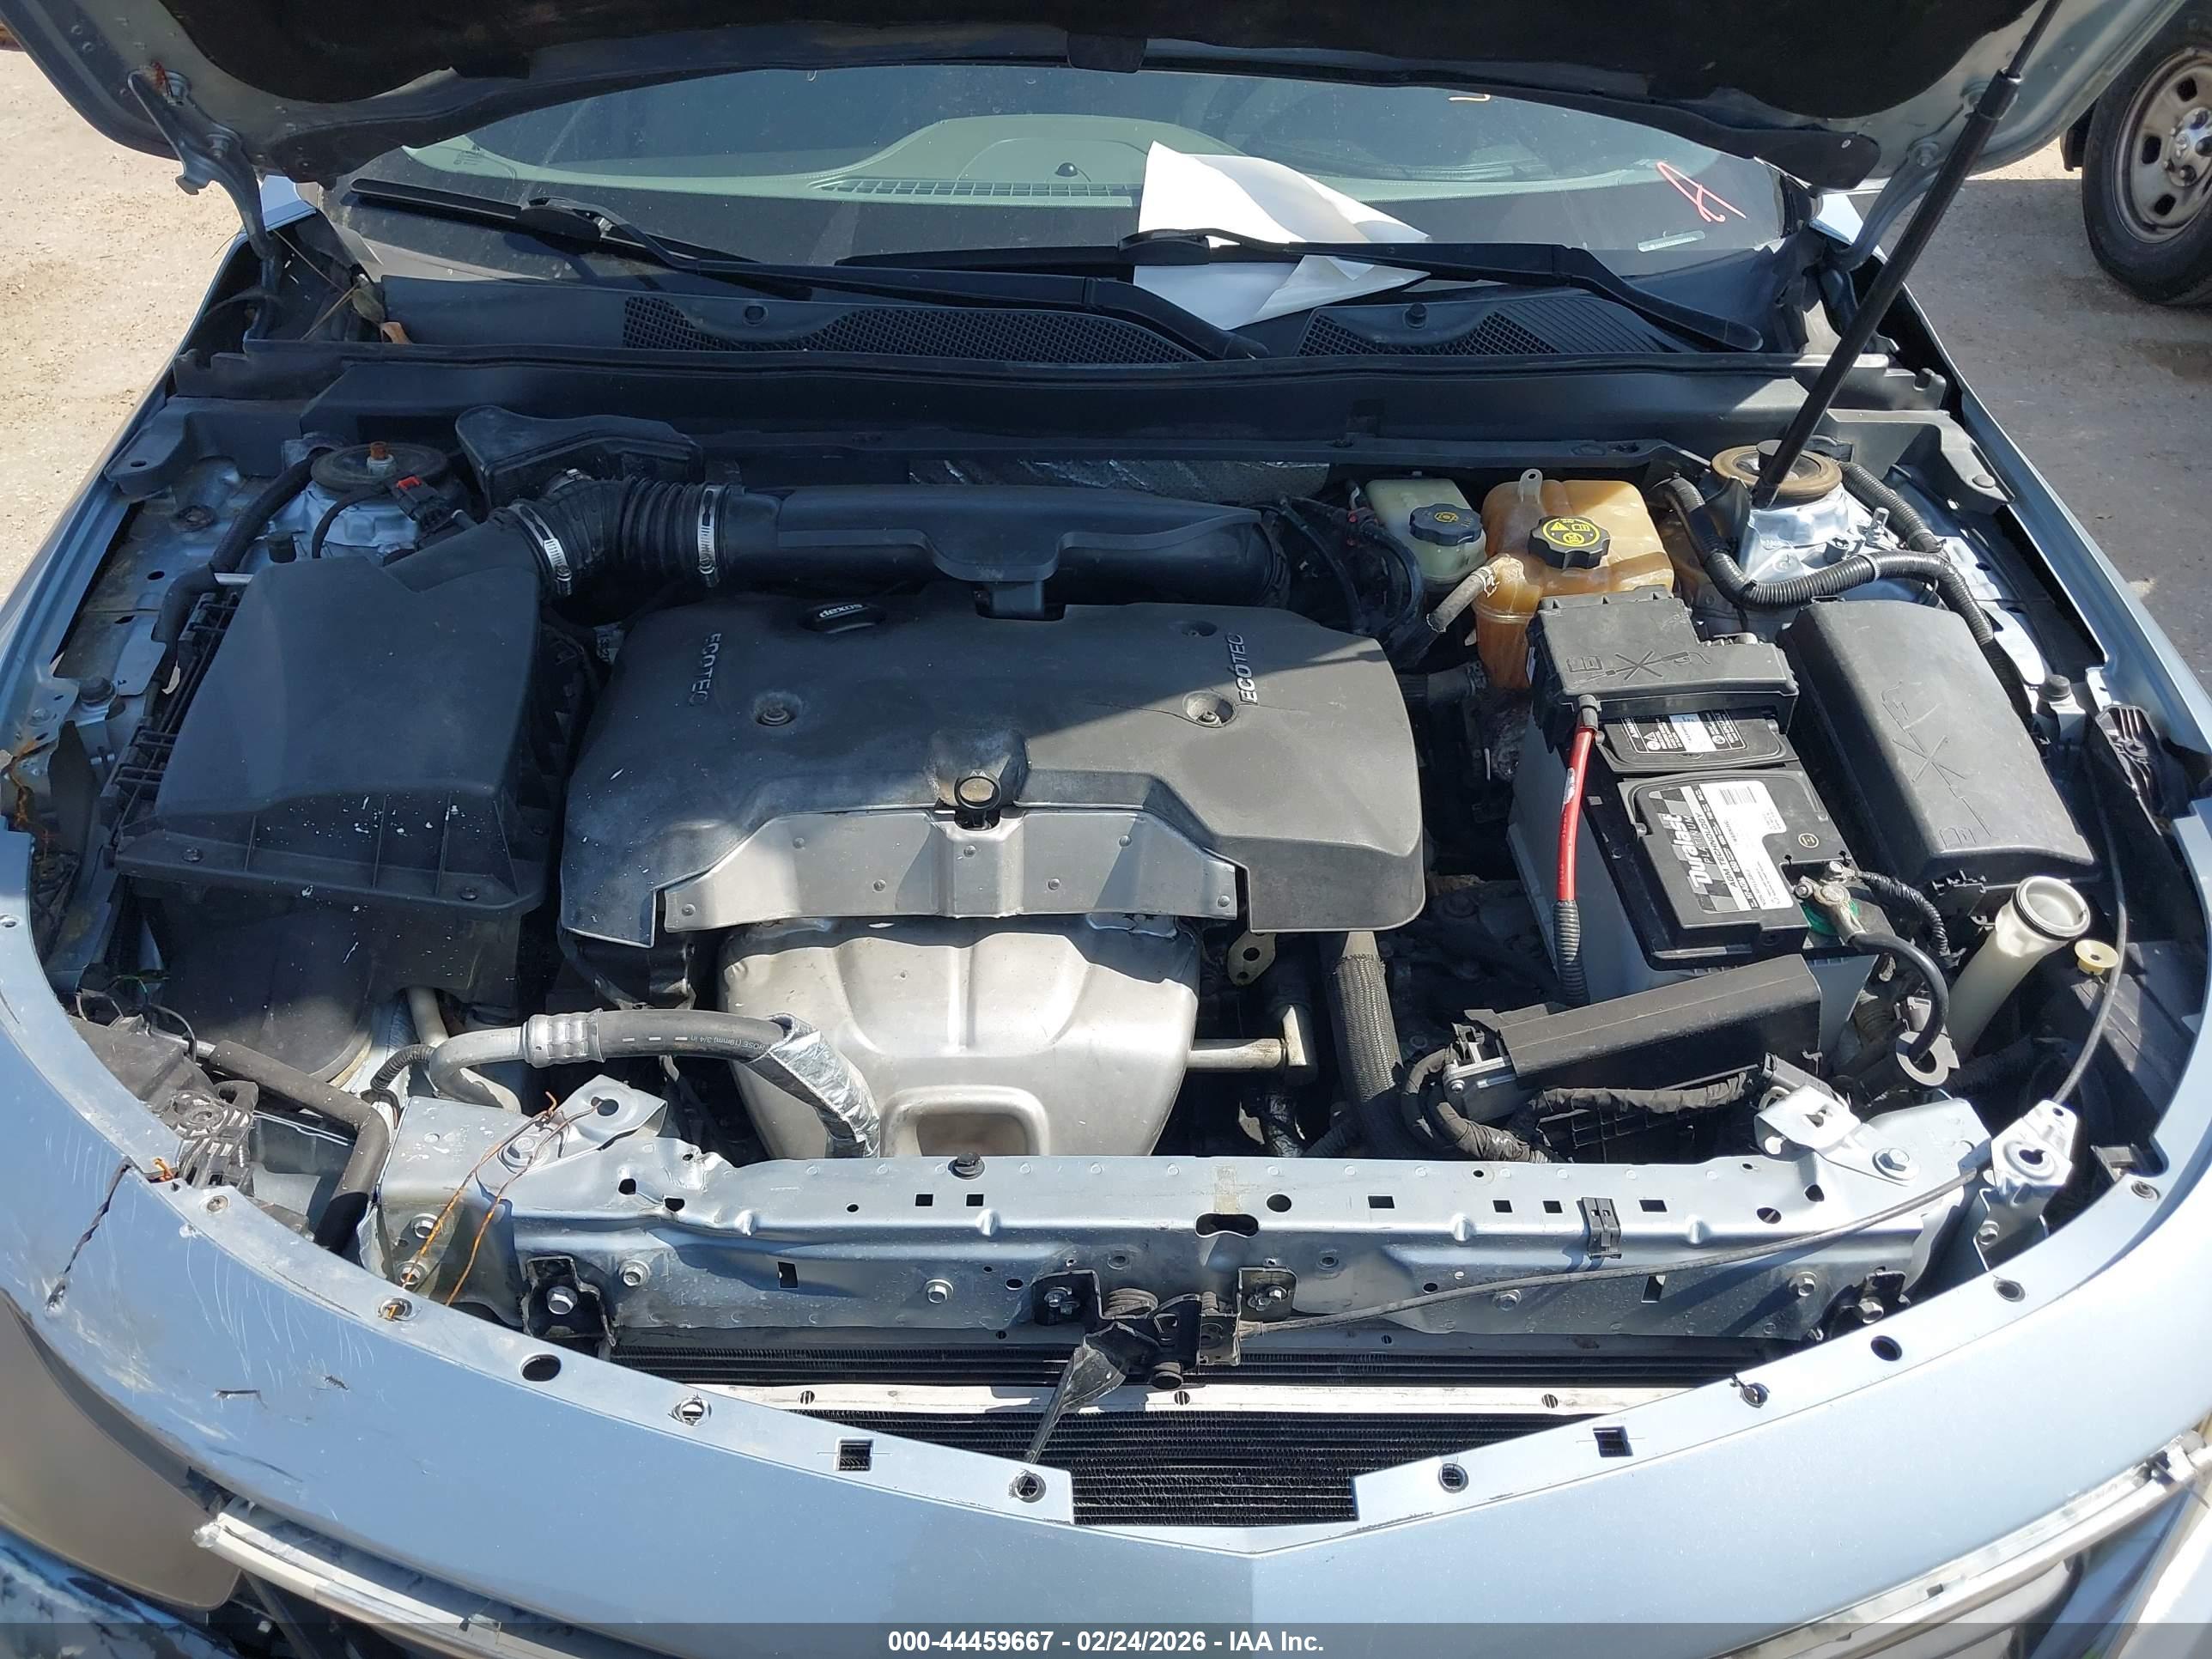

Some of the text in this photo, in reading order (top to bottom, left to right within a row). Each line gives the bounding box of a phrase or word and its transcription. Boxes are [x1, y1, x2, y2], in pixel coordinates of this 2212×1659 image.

[818, 604, 863, 617] dexos
[689, 633, 721, 702] ECOTEC
[1227, 632, 1258, 703] ECOTEC
[1662, 813, 1713, 888] Duralast
[1681, 815, 1717, 864] PLATINUM
[1695, 812, 1725, 866] TECHNOLOGY
[1723, 867, 1738, 888] AGM
[690, 1034, 698, 1042] in
[714, 1036, 742, 1047] (19mm)
